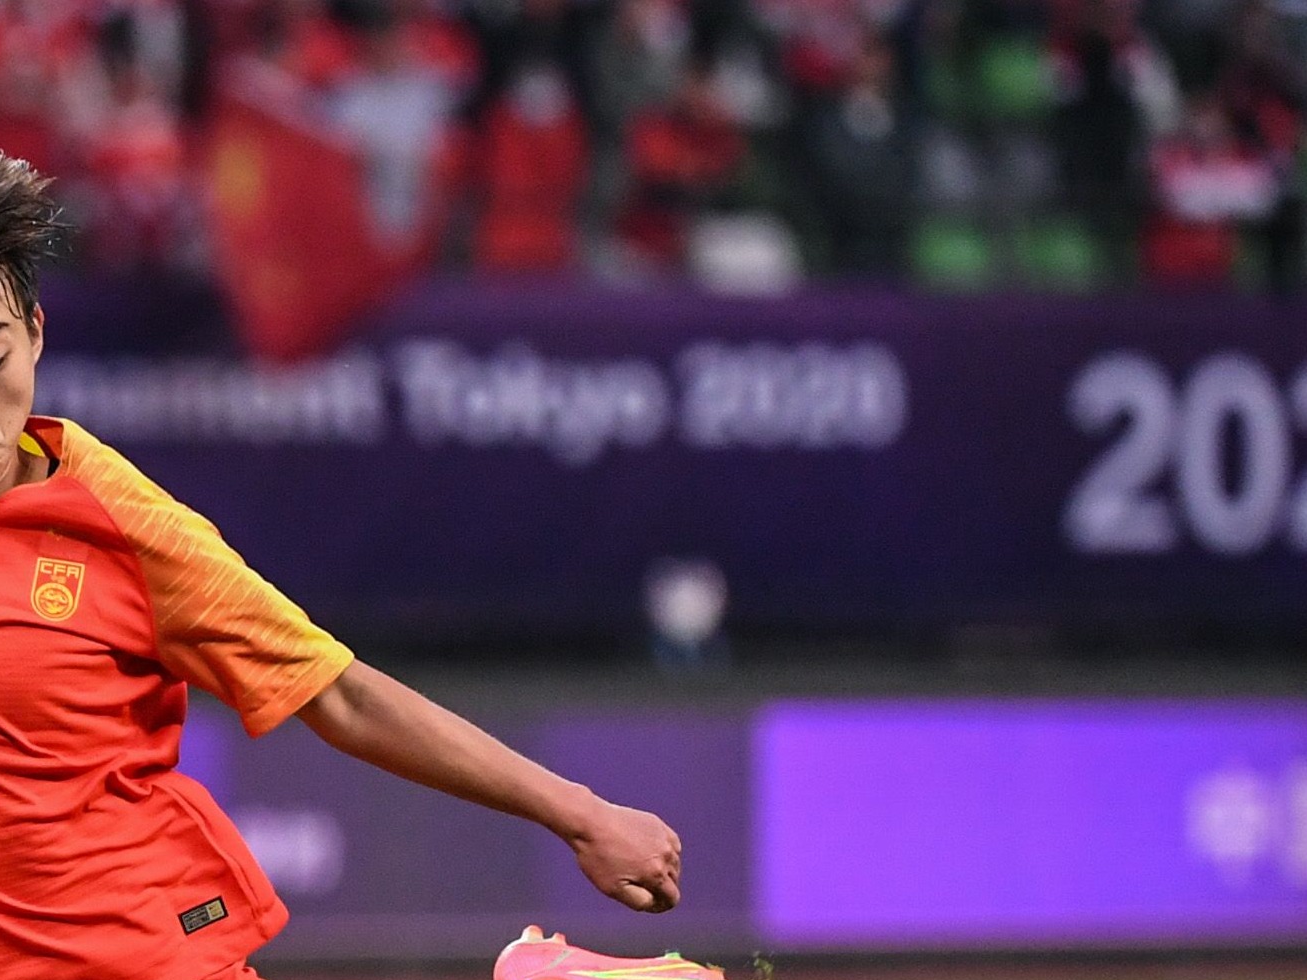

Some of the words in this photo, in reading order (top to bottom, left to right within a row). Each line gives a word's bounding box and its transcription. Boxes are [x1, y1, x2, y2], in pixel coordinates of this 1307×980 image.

[397, 338, 670, 465] Tokyo
[679, 340, 907, 448] 2020
[1064, 352, 1307, 554] 20
[40, 561, 80, 580] CFA
